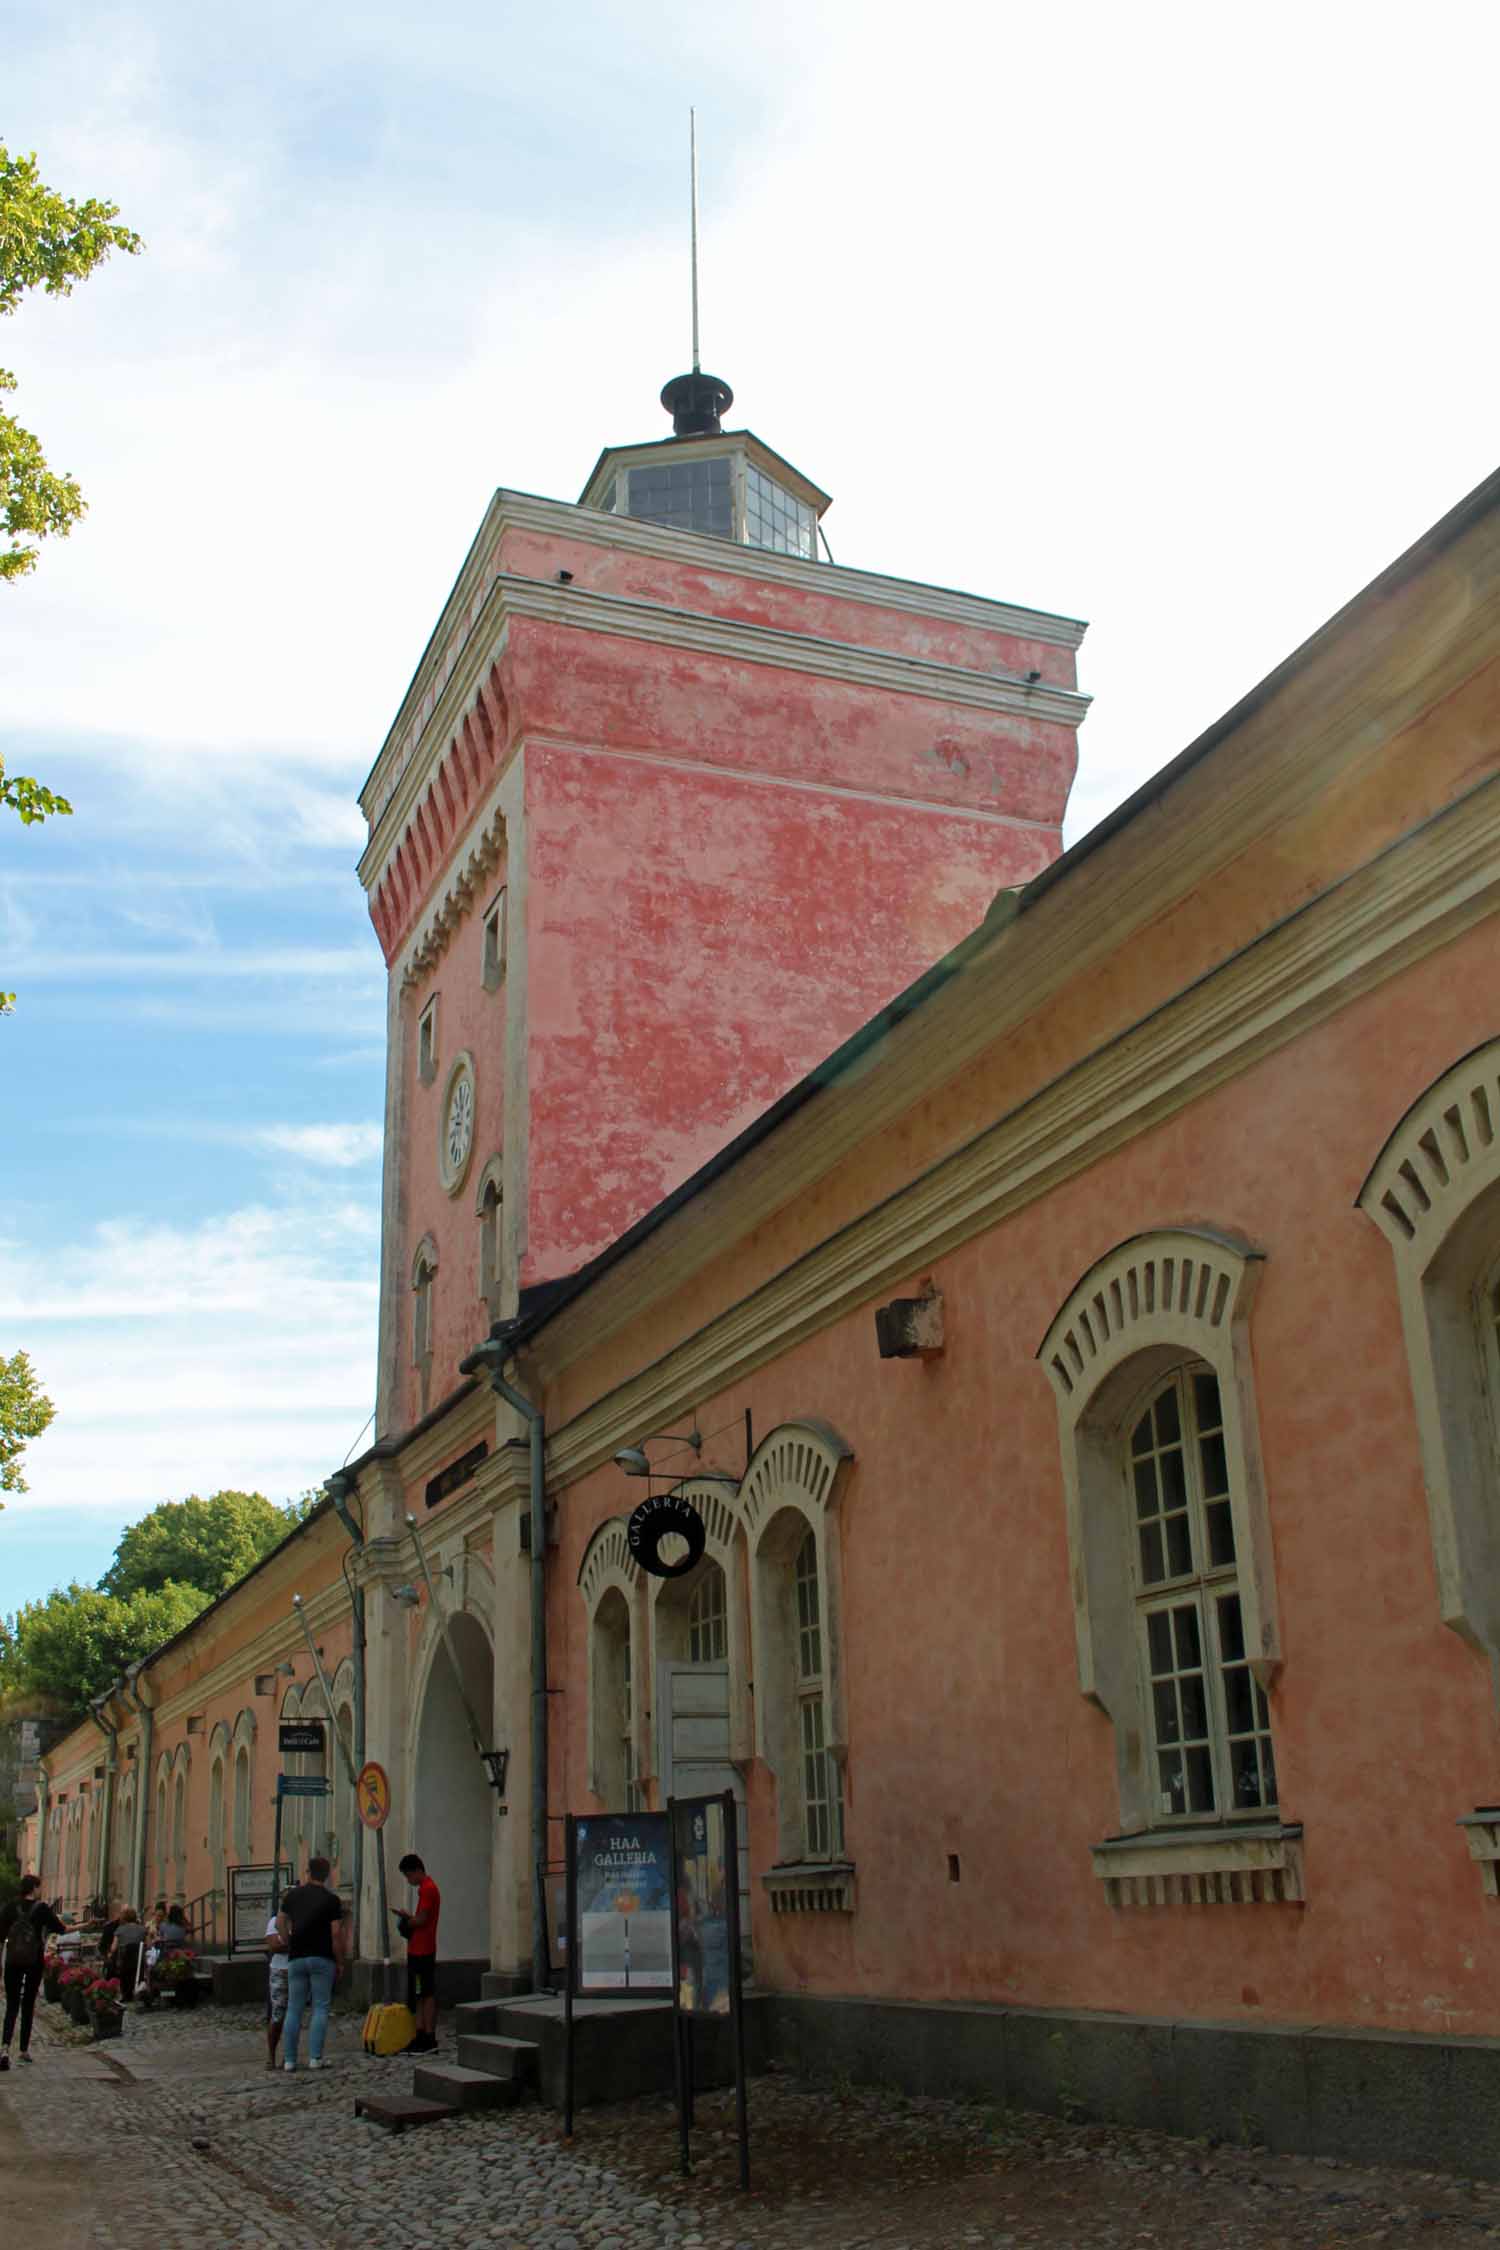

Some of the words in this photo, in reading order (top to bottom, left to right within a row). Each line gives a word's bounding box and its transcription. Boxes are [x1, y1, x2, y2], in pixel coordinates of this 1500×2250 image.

[630, 1497, 691, 1546] GALLERIA
[610, 1837, 640, 1850] HAA
[594, 1851, 656, 1866] GALLERIA
